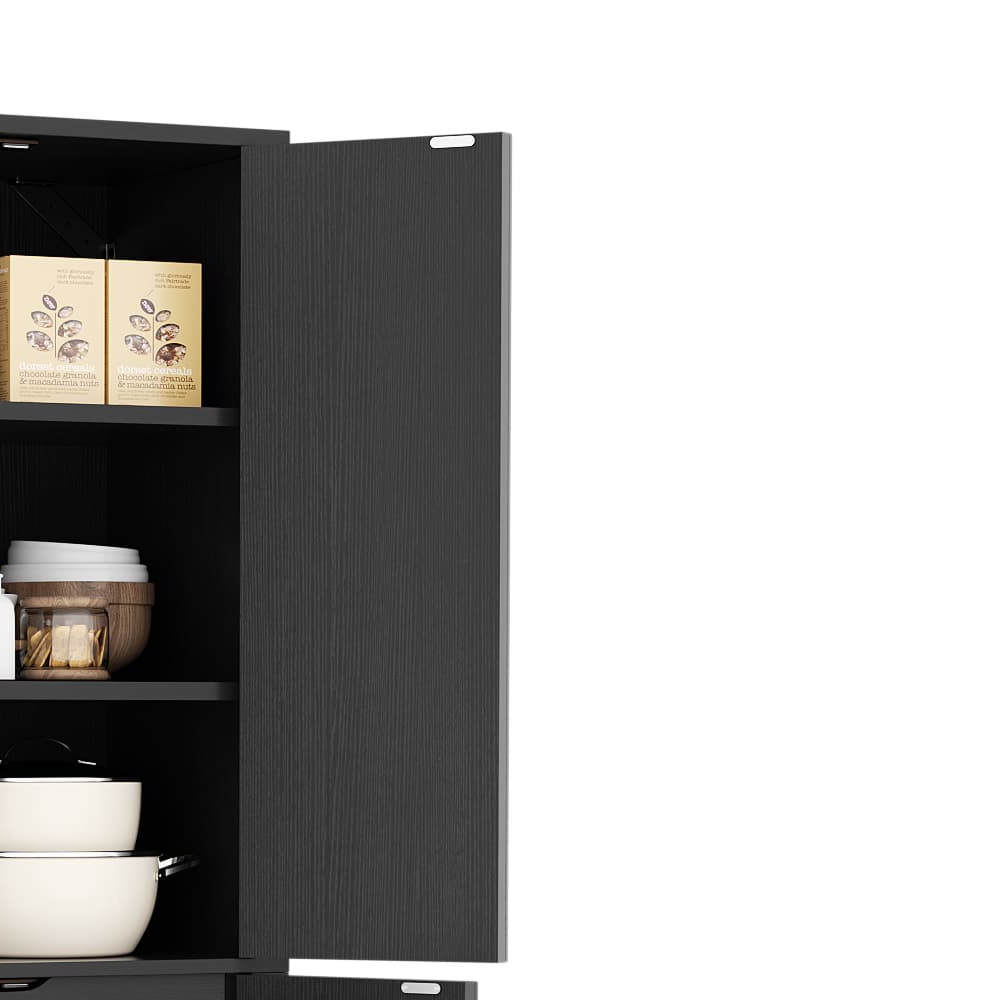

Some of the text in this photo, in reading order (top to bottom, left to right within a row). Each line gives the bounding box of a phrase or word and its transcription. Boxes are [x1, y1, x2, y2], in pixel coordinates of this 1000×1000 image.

[19, 370, 97, 380] chocolate granola
[160, 375, 194, 383] granola
[28, 378, 79, 387] macadamia
[117, 381, 126, 389] &
[127, 382, 176, 390] macadamia
